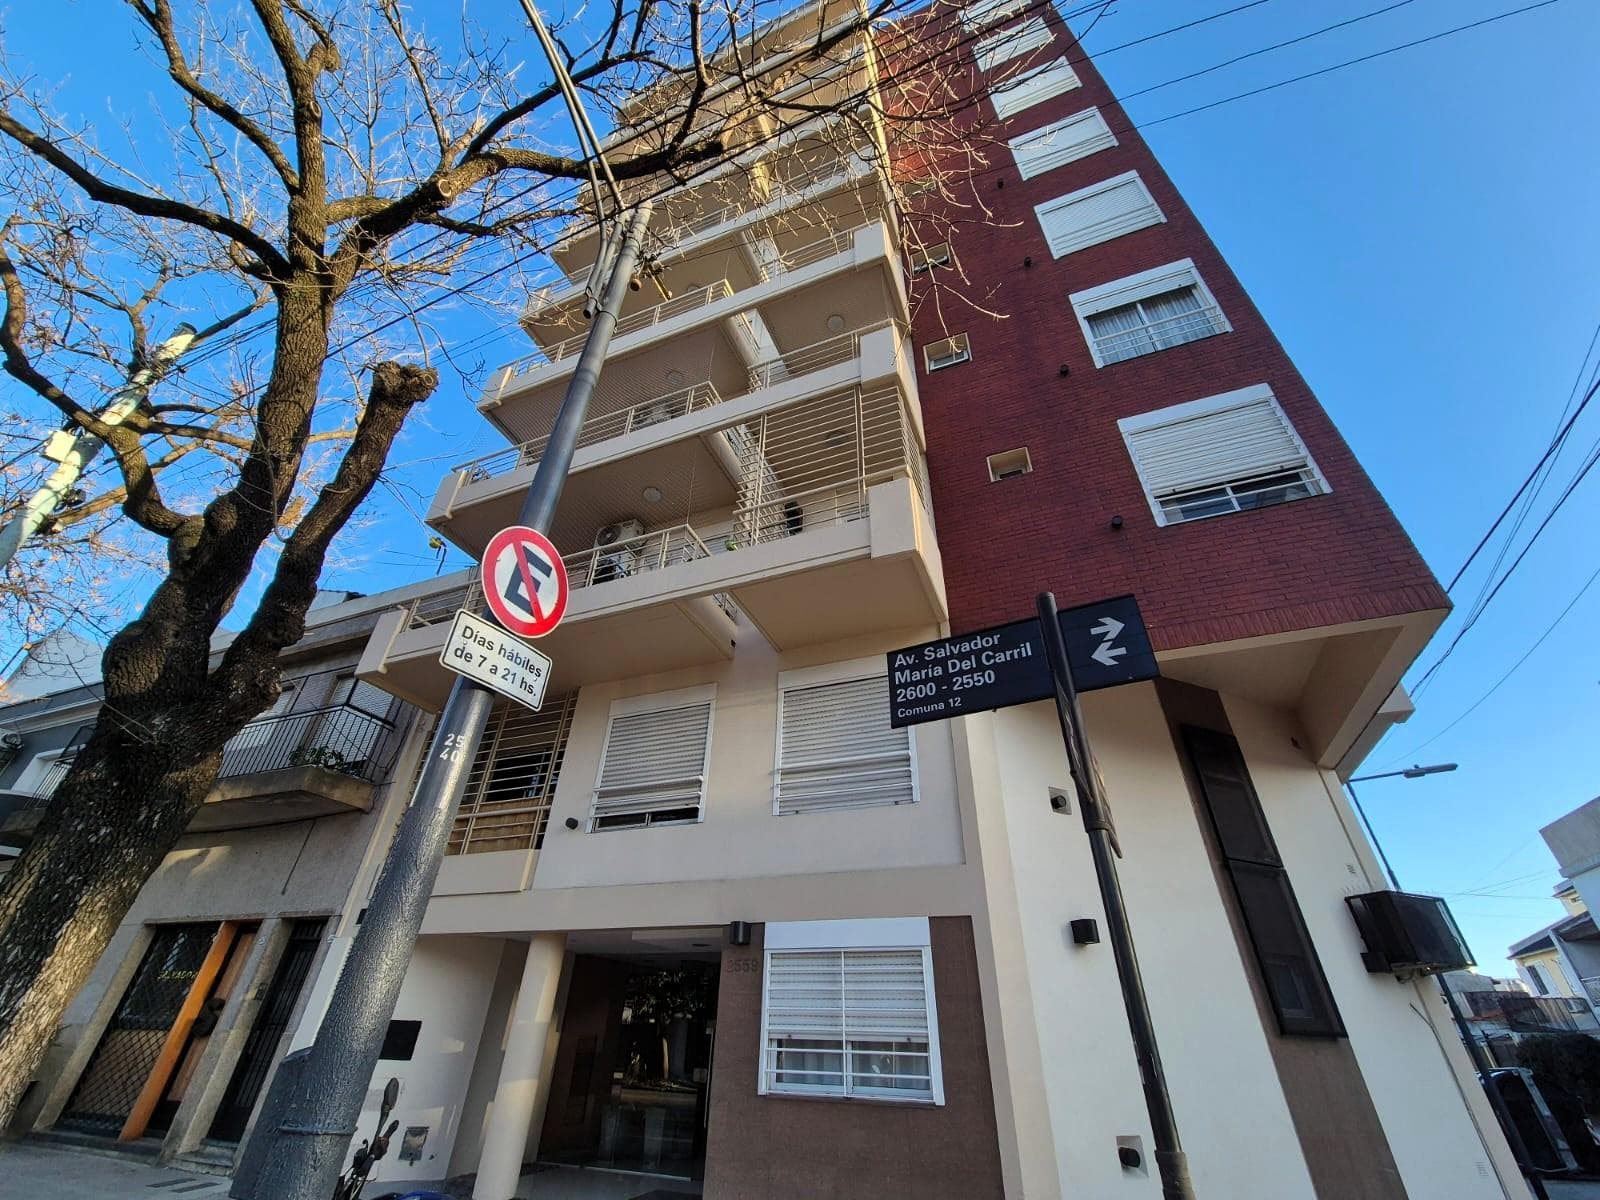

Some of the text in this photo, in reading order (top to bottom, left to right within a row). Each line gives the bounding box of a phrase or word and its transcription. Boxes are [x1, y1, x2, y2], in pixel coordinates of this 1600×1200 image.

[462, 625, 542, 678] Días hábiles
[894, 634, 1000, 668] Av. Salvador
[895, 642, 1032, 685] María Del Carril
[454, 646, 536, 696] de 7 a 21 hs.
[896, 682, 936, 702] 2600
[952, 670, 996, 691] 2550
[897, 697, 962, 718] Comuna 12
[439, 748, 461, 766] 40
[444, 733, 466, 748] 25
